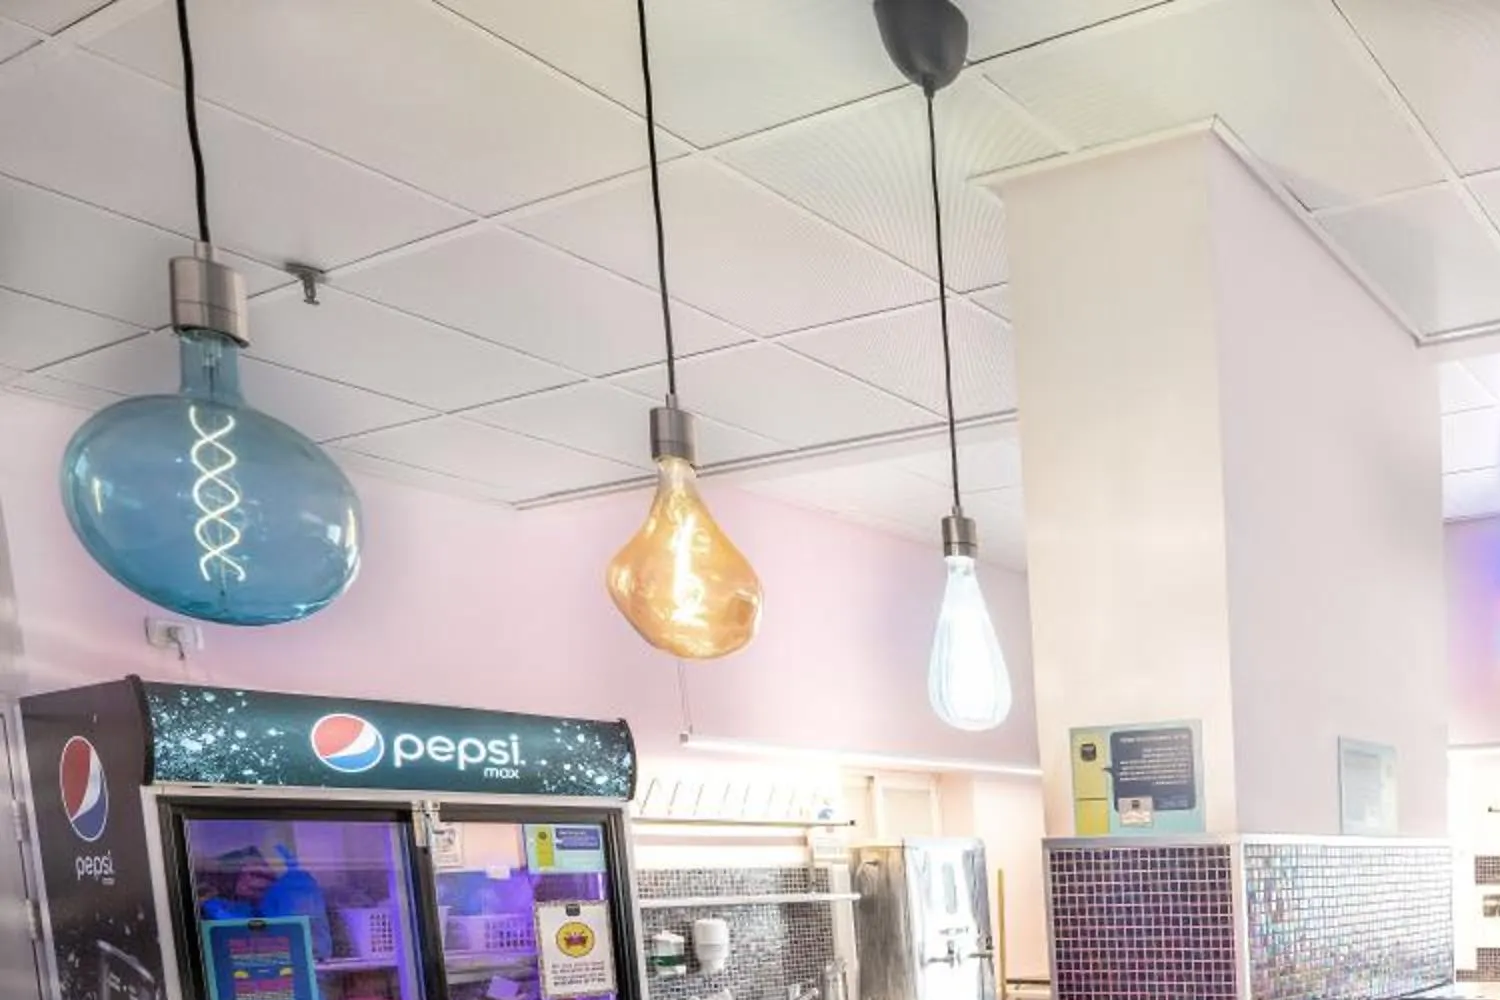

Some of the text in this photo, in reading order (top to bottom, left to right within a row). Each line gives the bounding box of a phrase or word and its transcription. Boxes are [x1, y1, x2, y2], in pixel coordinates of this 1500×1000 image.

[394, 733, 523, 770] pepsi
[484, 766, 520, 780] max
[75, 850, 114, 881] pepsi
